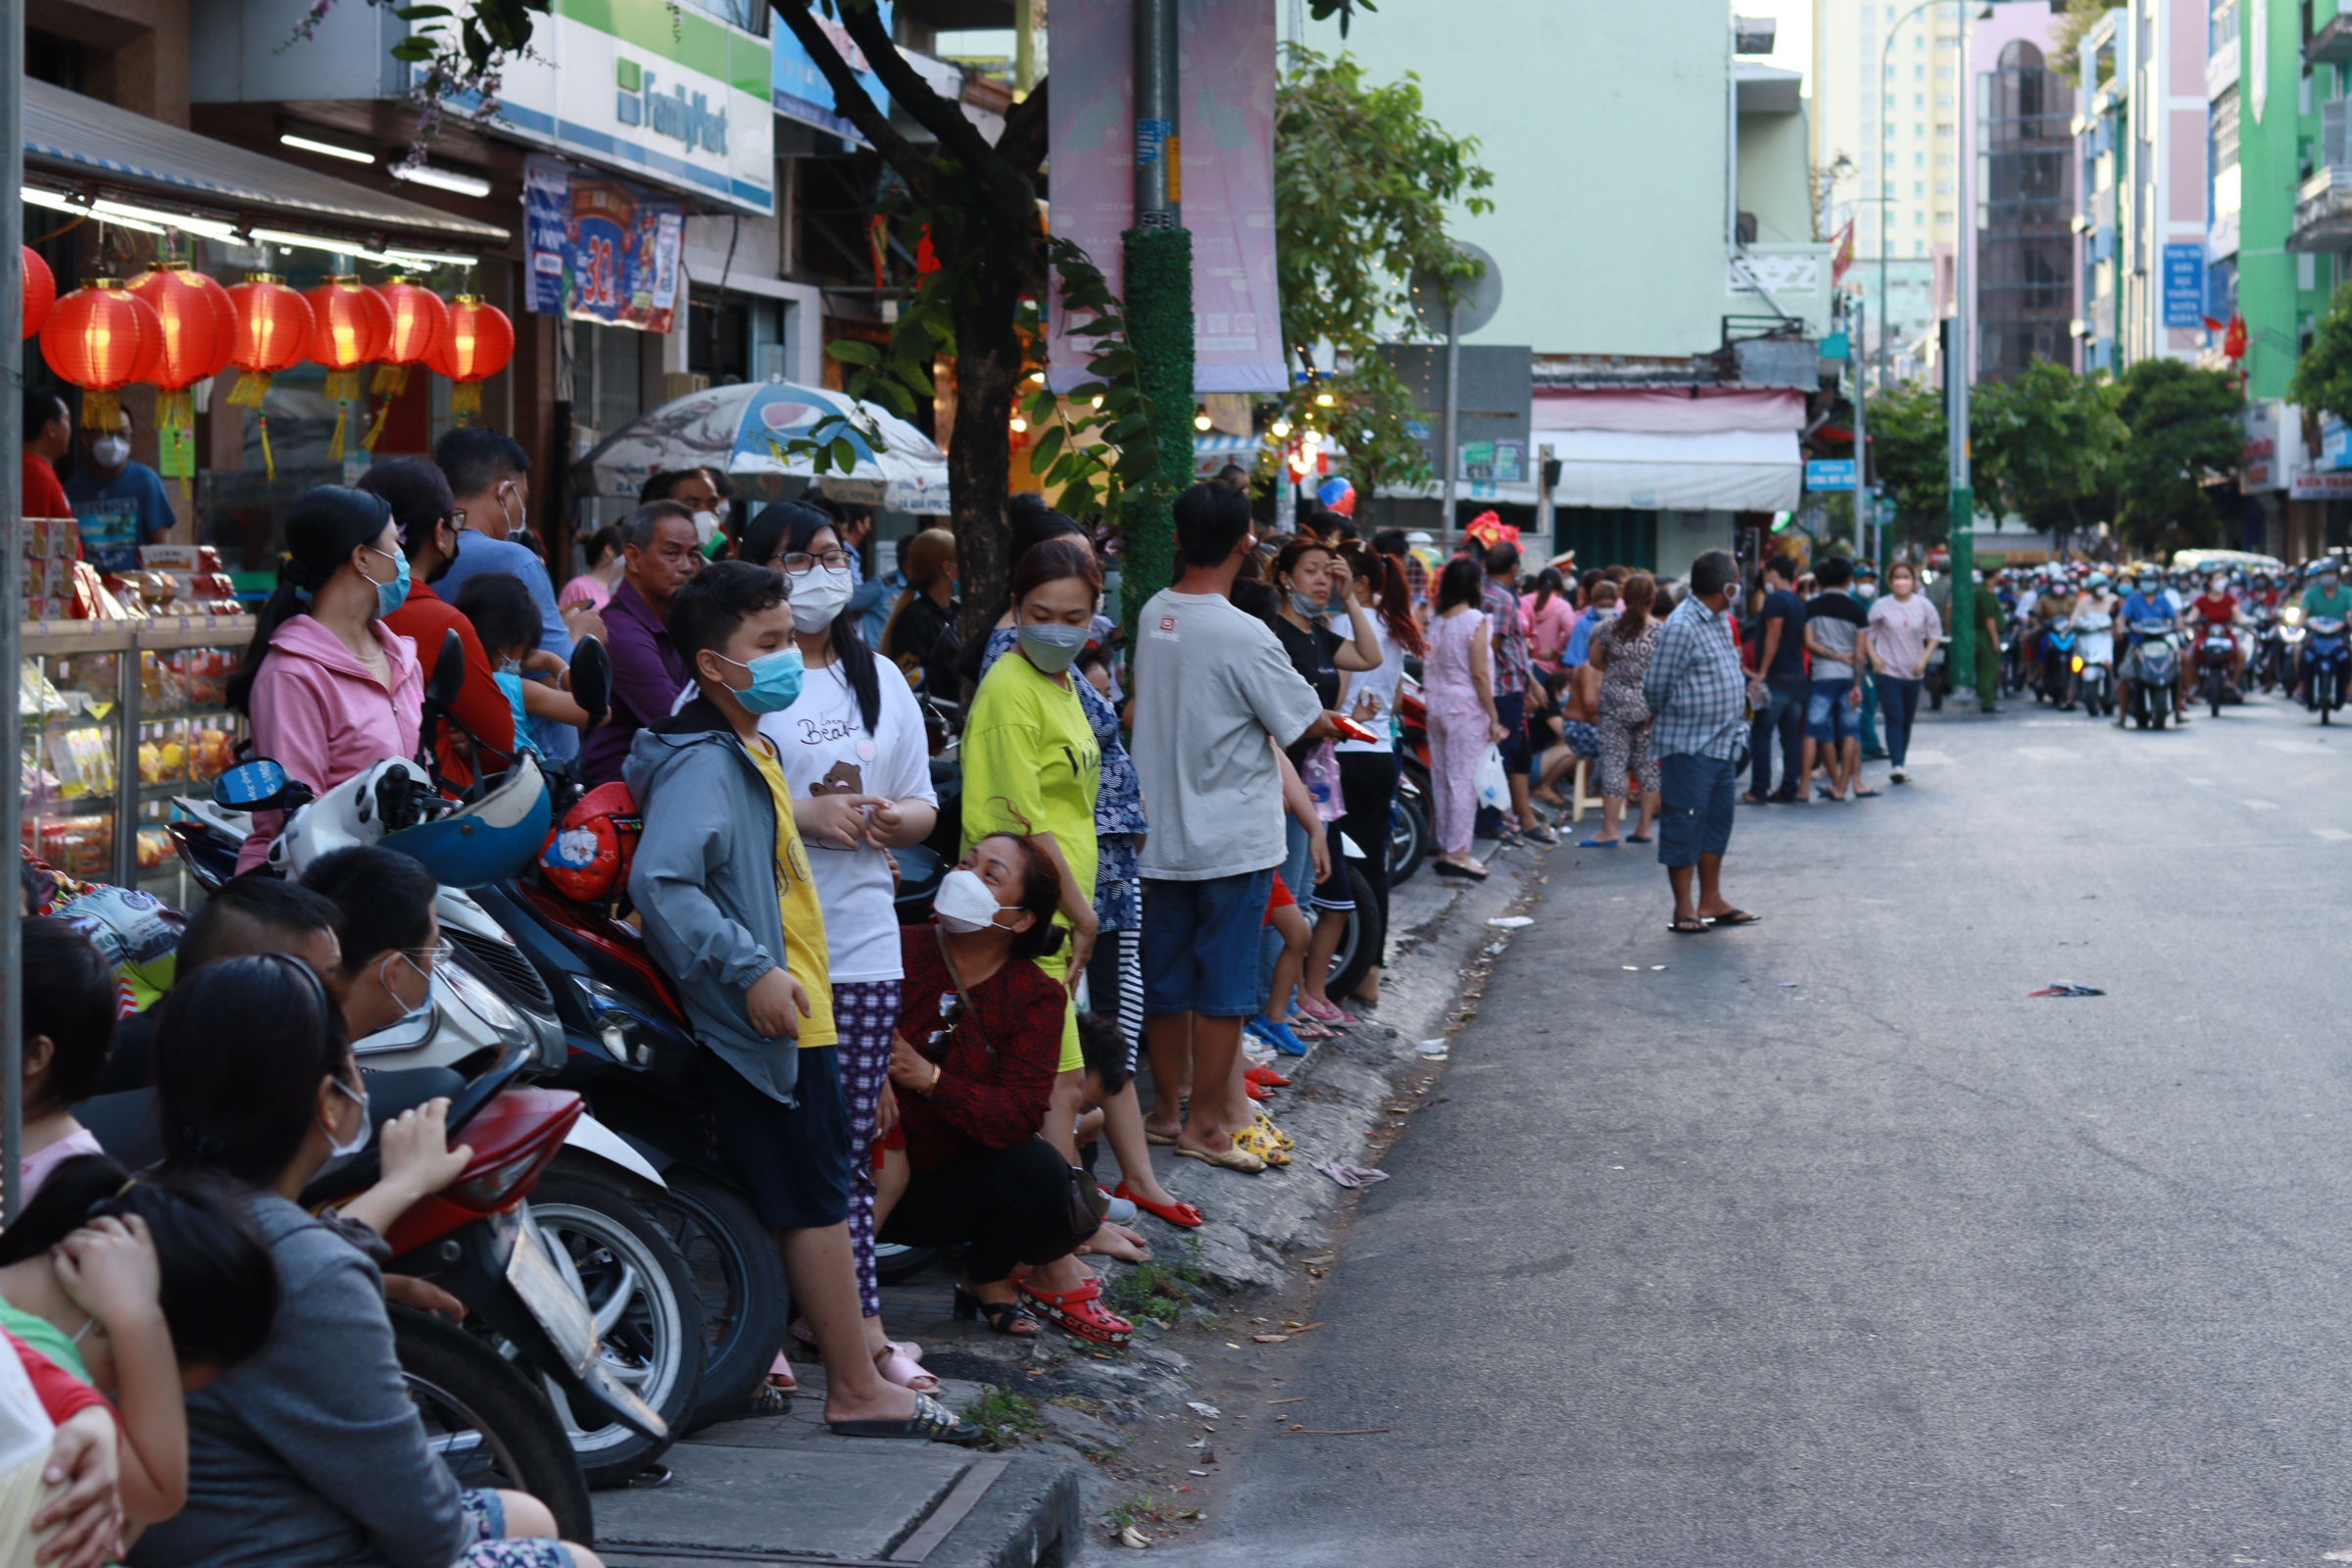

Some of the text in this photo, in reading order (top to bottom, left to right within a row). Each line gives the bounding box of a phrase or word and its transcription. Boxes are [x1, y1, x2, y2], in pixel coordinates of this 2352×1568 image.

[644, 71, 728, 157] FamilyMart
[797, 718, 860, 745] Bear
[1065, 1316, 1111, 1341] crocs
